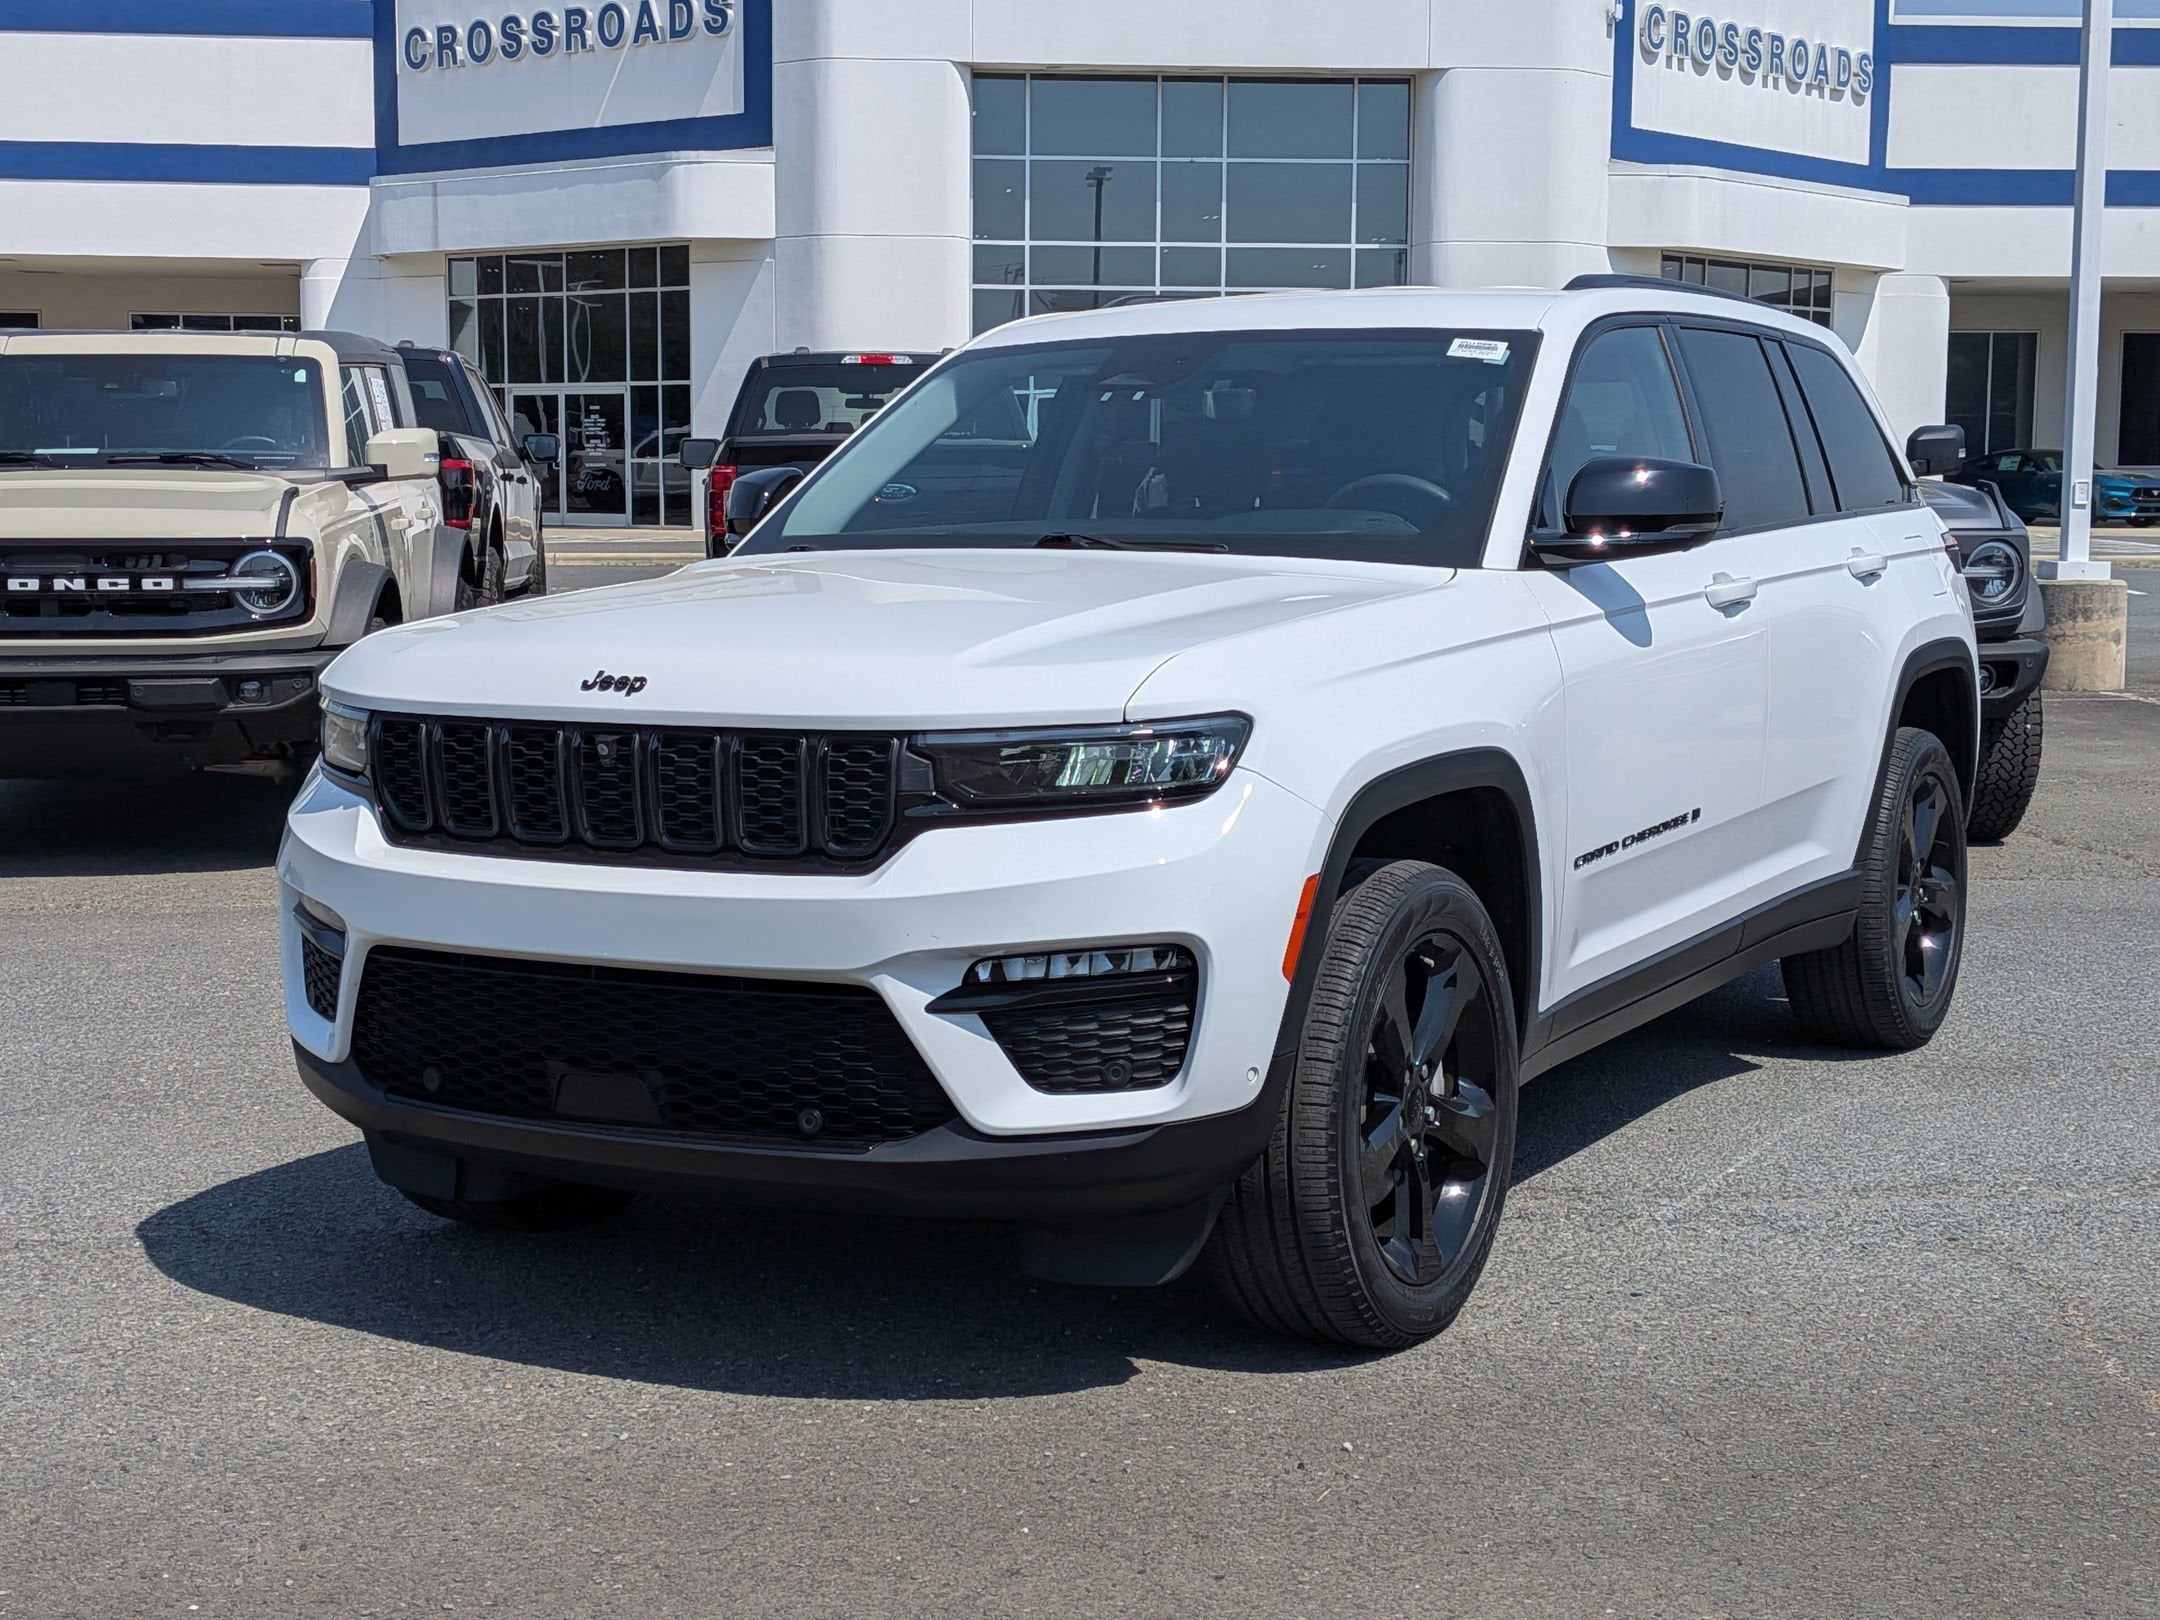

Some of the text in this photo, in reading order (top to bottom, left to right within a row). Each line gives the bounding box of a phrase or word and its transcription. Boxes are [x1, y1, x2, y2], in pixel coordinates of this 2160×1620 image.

[404, 0, 735, 71] CROSSROADS
[1643, 4, 1873, 95] CROSSROADS
[576, 469, 611, 492] Ford
[7, 578, 174, 591] ONCO
[580, 670, 648, 697] Jeep
[1573, 812, 1690, 871] GRAND CHEROKEE
